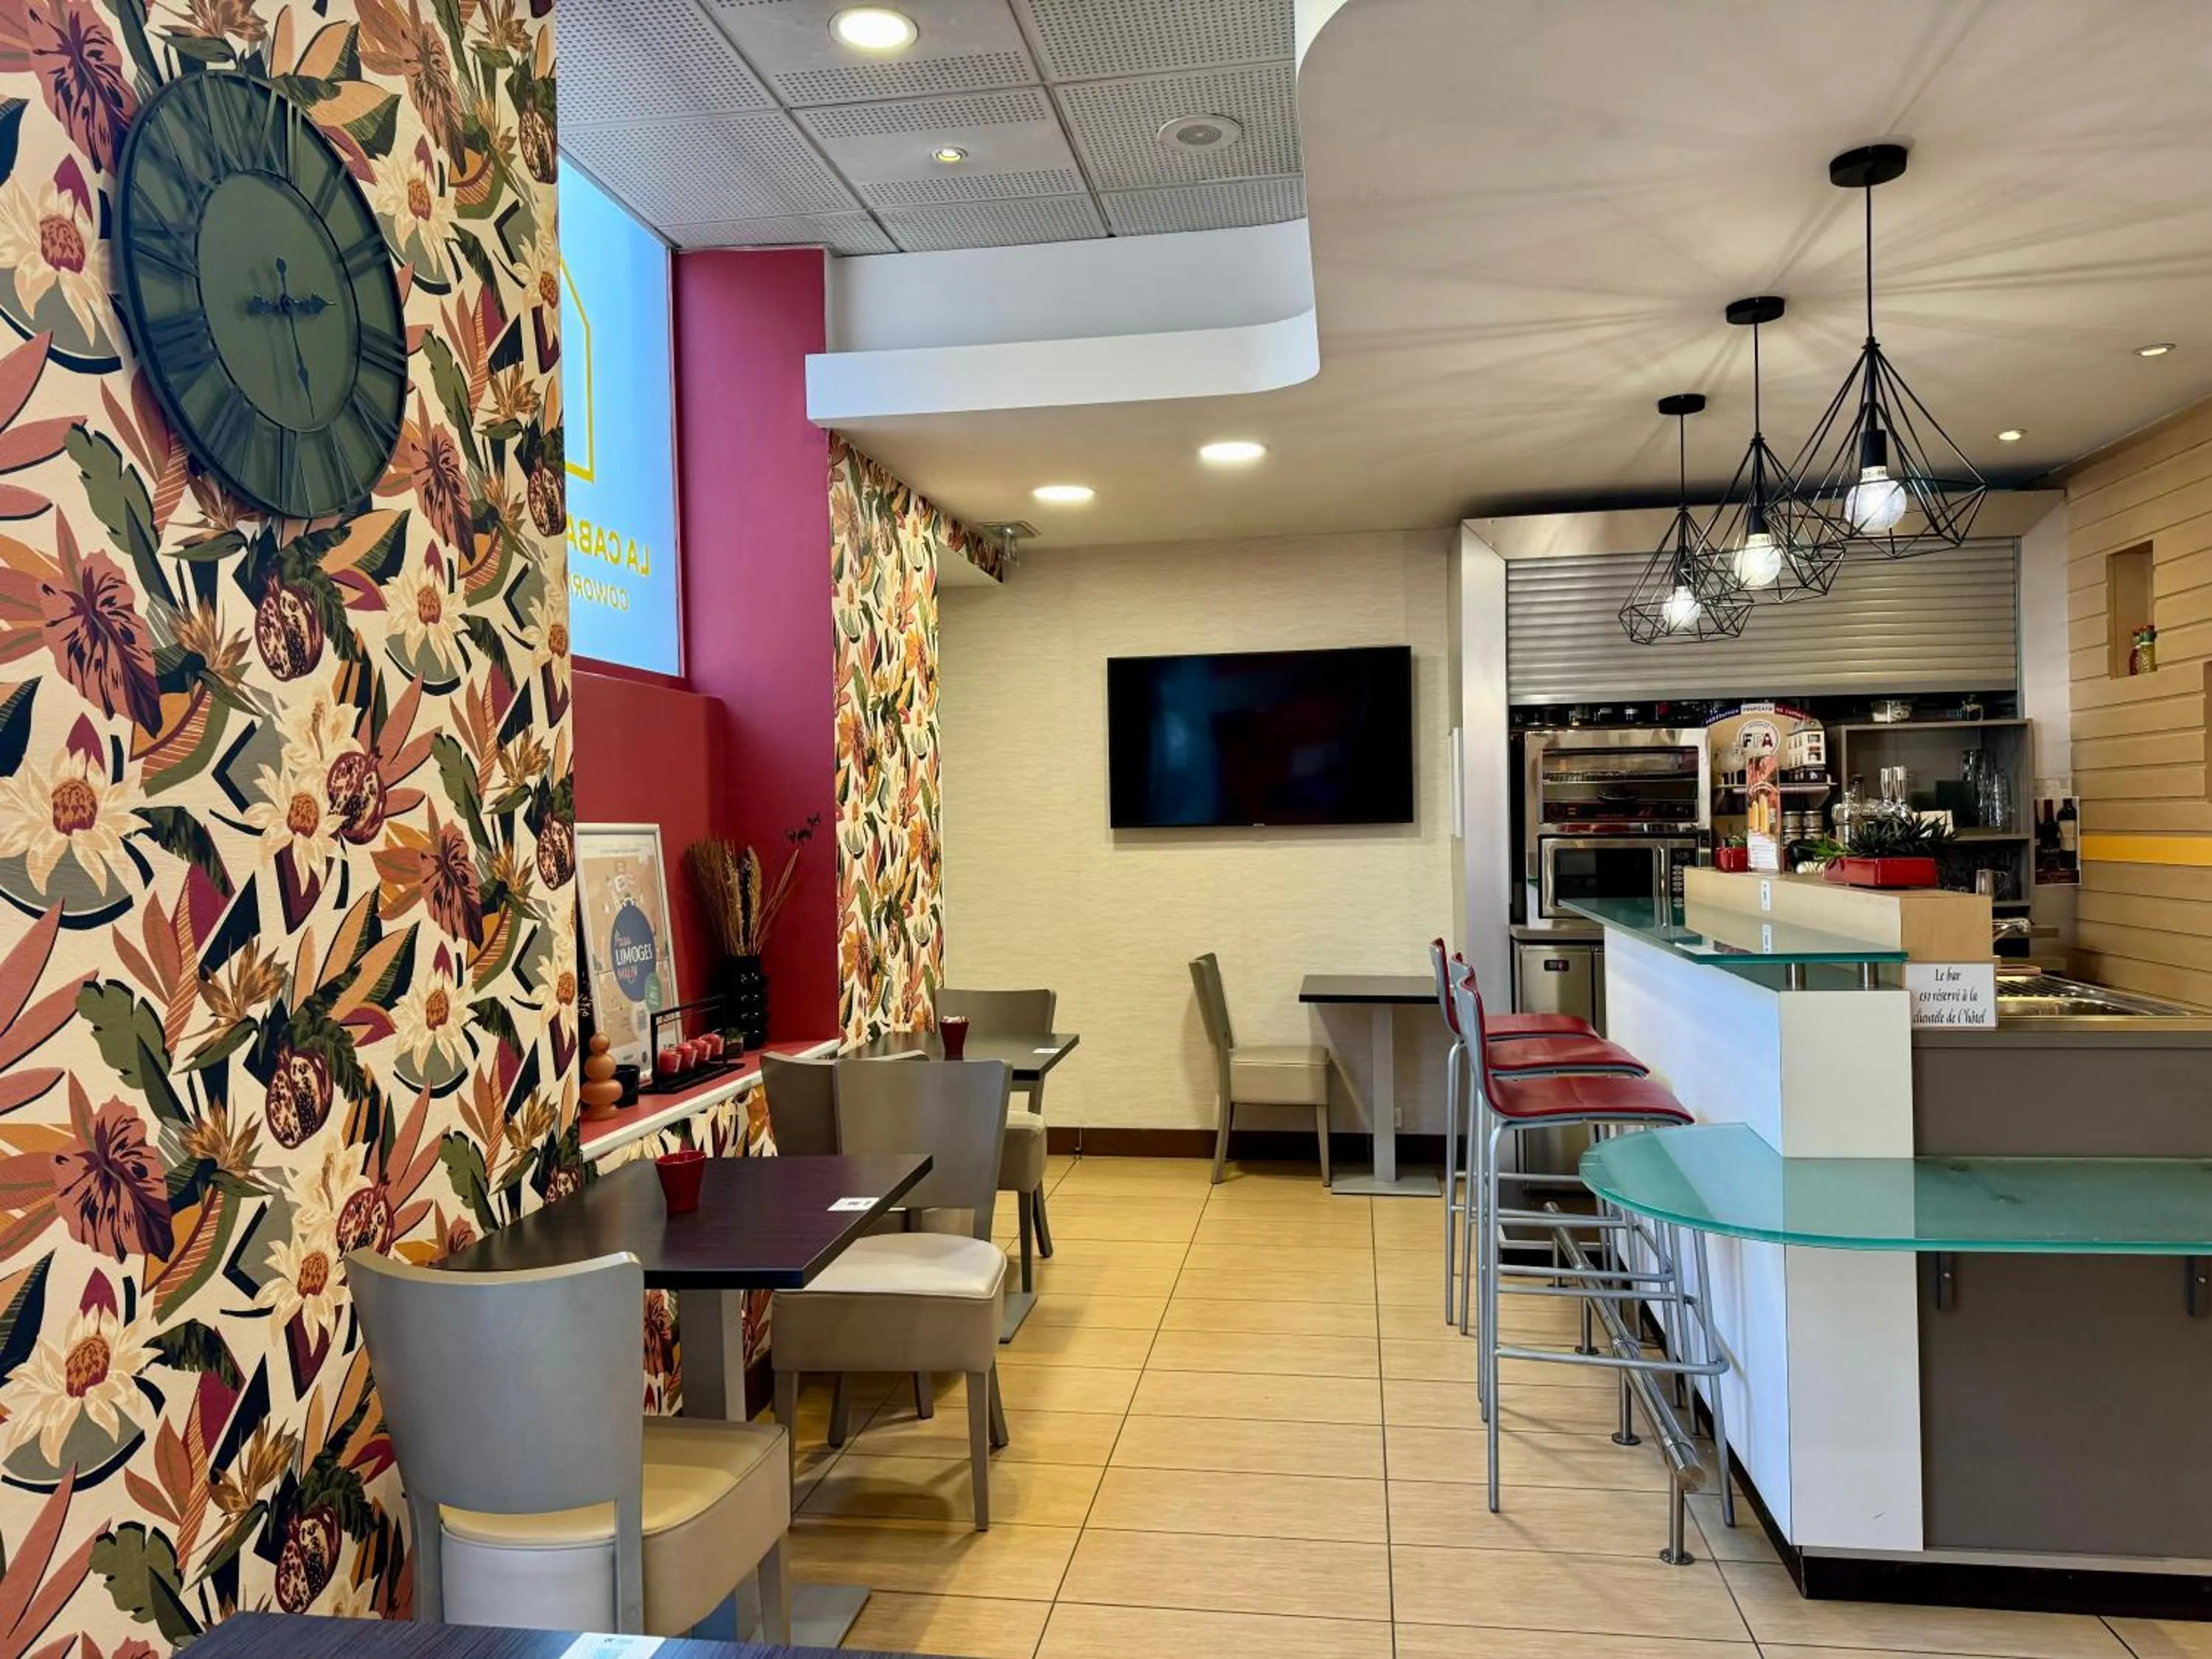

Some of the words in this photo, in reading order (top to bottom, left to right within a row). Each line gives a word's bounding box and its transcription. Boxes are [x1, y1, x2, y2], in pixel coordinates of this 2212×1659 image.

[1742, 734, 1773, 748] FFA
[616, 945, 653, 966] LIMOGES
[1935, 968, 1944, 981] Le
[1947, 967, 1961, 981] bar
[1933, 988, 1961, 1002] réservé
[1962, 989, 1968, 1002] à
[1970, 987, 1978, 1002] la
[1947, 1009, 1956, 1023] de
